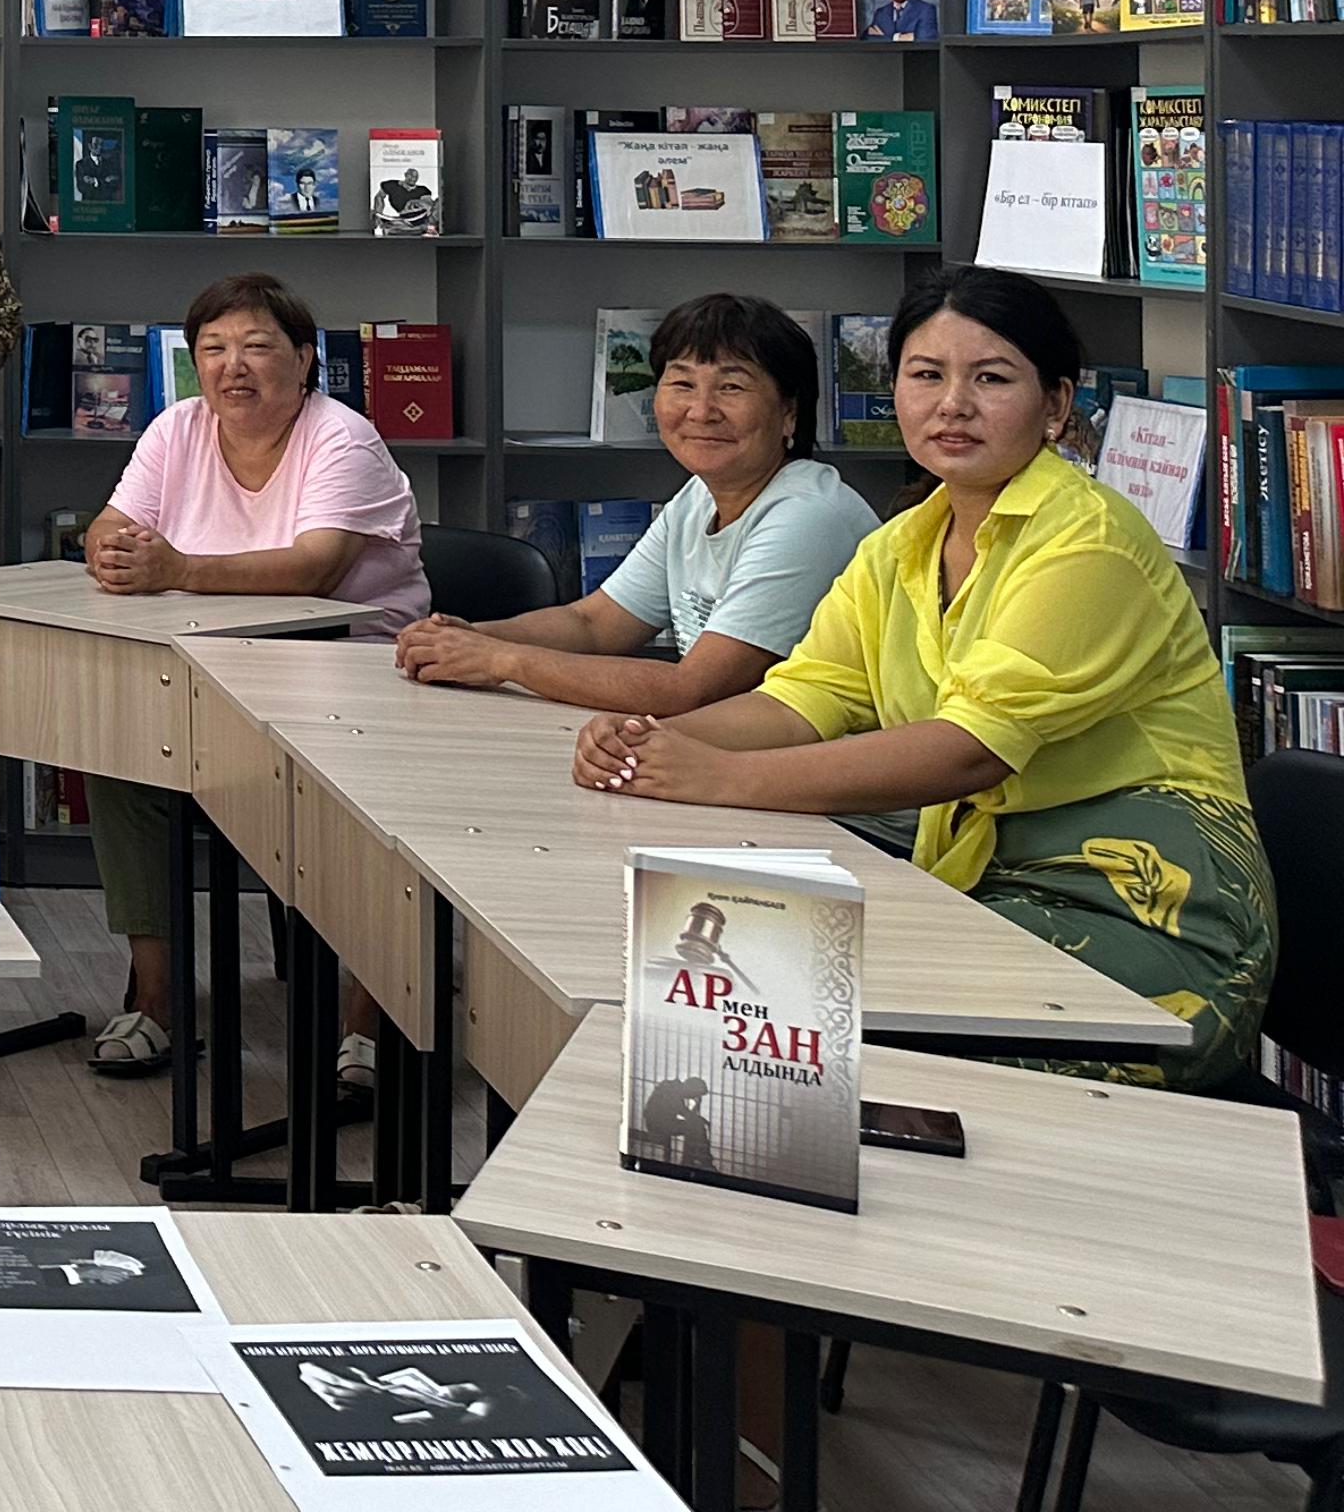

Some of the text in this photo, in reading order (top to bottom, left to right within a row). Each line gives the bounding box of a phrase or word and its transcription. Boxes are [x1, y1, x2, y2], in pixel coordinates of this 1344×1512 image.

[1012, 114, 1072, 125] АСТРОНОМИЯ
[995, 190, 1016, 208] «Бір
[1041, 192, 1058, 210] бір
[1258, 424, 1270, 501] Жетісу
[664, 968, 733, 1011] АР
[721, 997, 769, 1020] мен
[721, 1014, 825, 1076] ЗАҢ
[722, 1055, 824, 1087] АЛДЫНДА
[314, 1435, 612, 1463] ЖЕМҚОРЛЫҚҚА ЖОЛ ЖОҚ!
